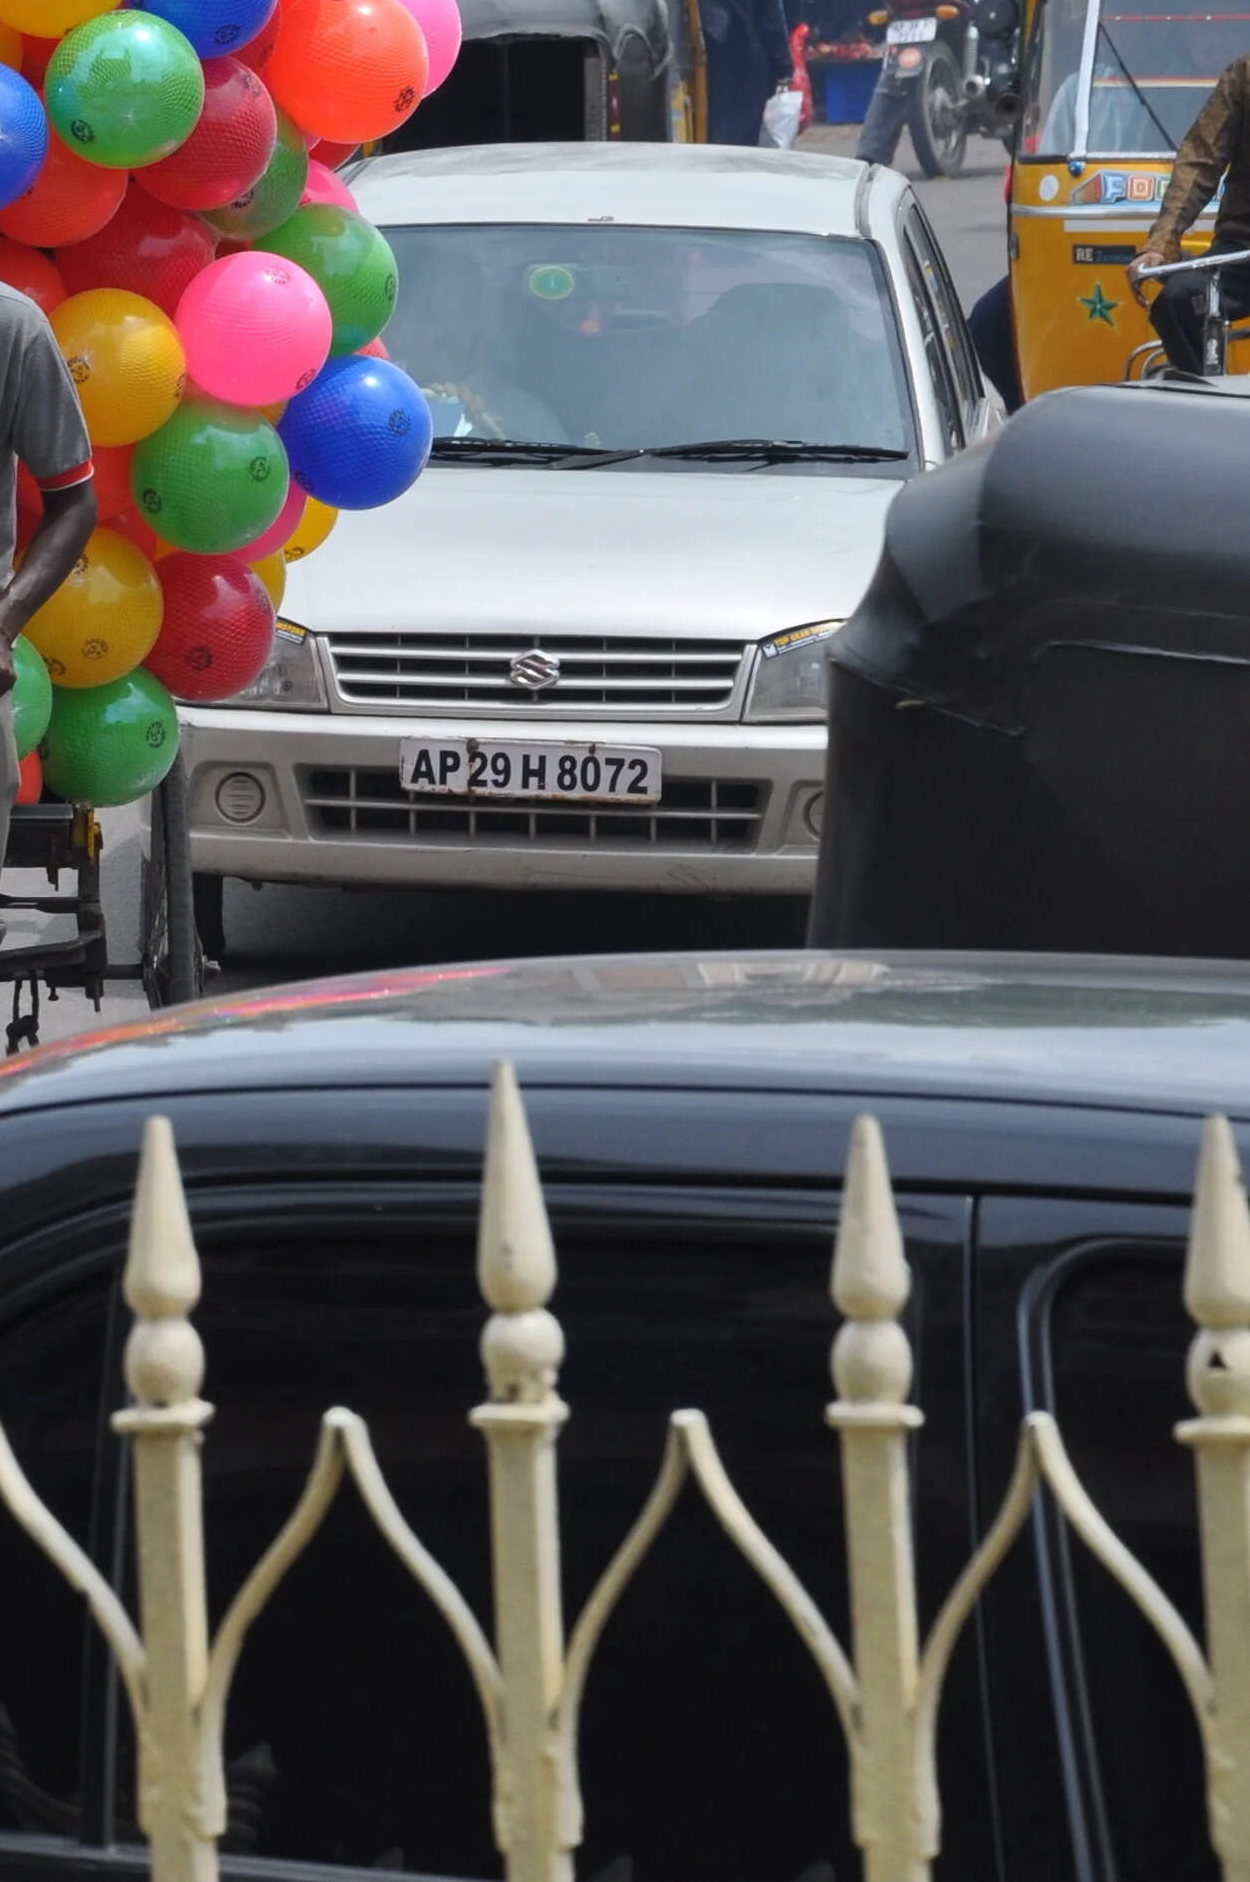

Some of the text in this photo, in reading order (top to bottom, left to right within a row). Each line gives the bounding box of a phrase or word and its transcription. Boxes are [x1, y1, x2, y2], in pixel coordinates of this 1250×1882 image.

[410, 749, 649, 795] AP 29 H 8072
